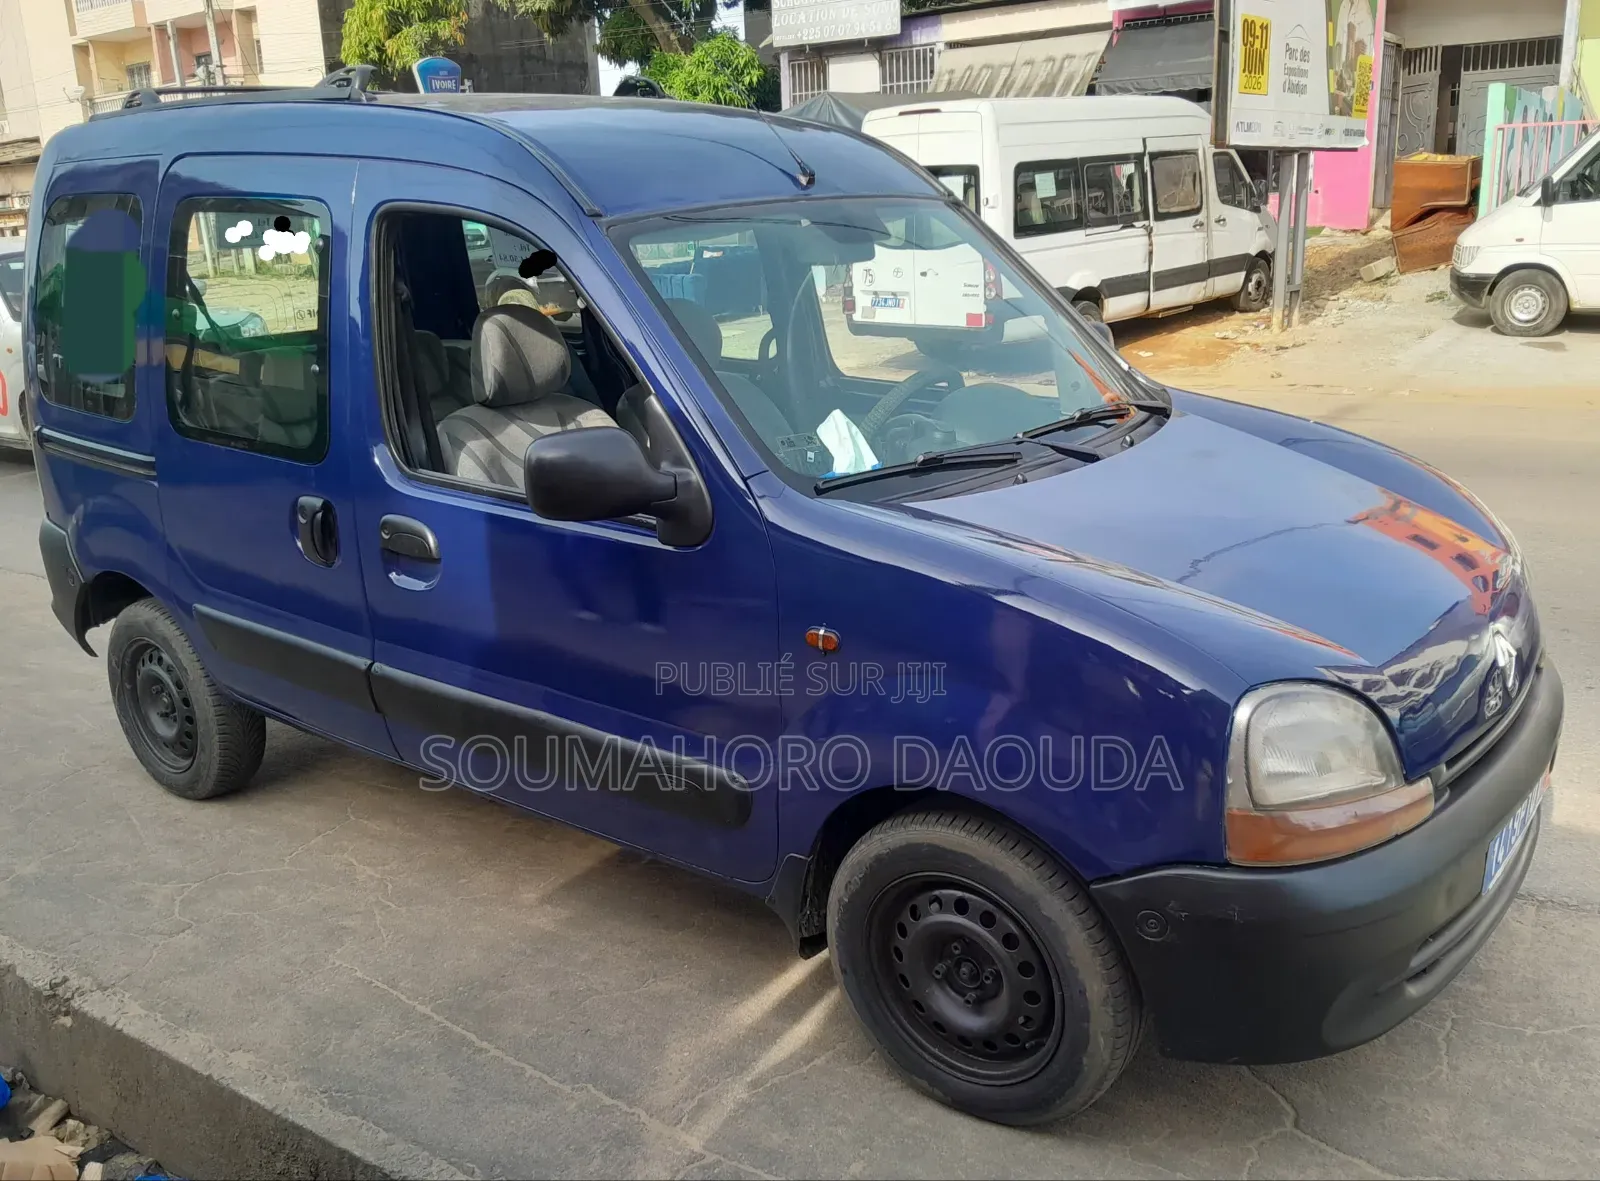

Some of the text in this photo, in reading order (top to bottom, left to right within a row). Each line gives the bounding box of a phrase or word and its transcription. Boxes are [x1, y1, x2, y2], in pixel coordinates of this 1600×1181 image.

[774, 9, 836, 27] LOCATION
[796, 27, 821, 40] +225
[823, 25, 835, 38] 07
[838, 23, 851, 36] 07
[1242, 18, 1269, 50] 09-11
[1284, 42, 1311, 63] Parc des
[1242, 47, 1265, 76] JUIN
[431, 78, 456, 90] IVOIRE
[1243, 75, 1262, 90] 2026
[862, 268, 874, 284] 75
